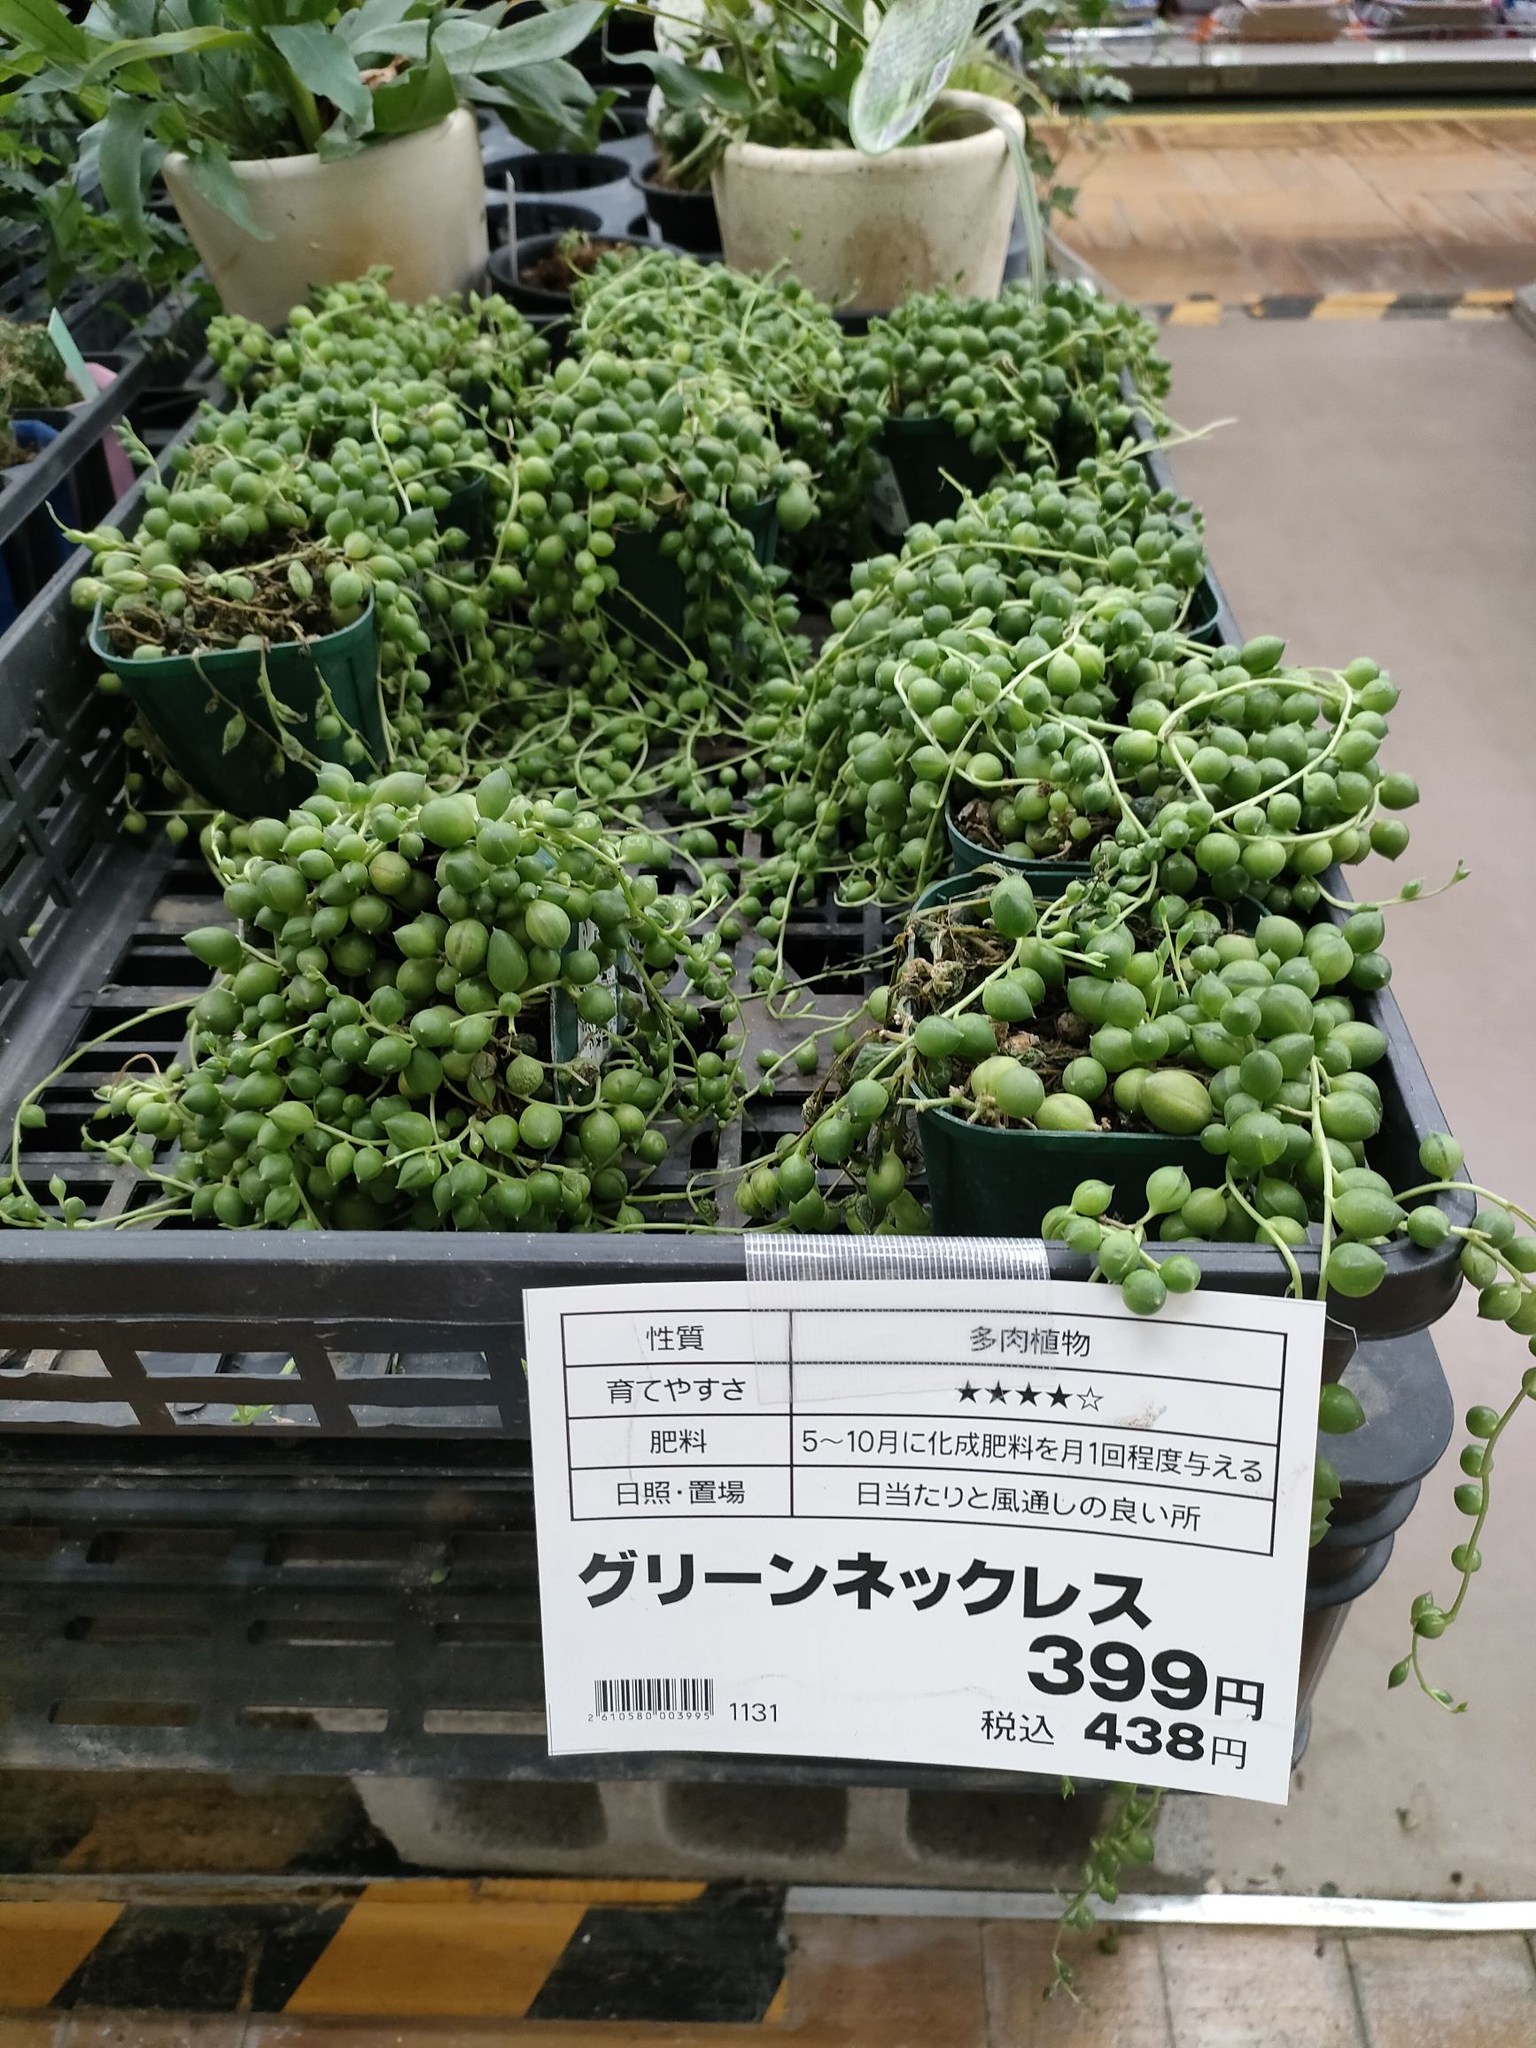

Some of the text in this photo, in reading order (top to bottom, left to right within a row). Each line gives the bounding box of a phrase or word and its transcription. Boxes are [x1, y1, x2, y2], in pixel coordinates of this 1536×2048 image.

[646, 1325, 705, 1352] 性質
[969, 1325, 1091, 1358] 多肉植物
[606, 1376, 747, 1405] 育てやすさ
[650, 1427, 708, 1455] 肥料
[856, 1481, 1202, 1532] 日当たりと風通しの良い所
[578, 1550, 1154, 1631] グリーンネックレス
[729, 1702, 778, 1723] 1131
[980, 1710, 1056, 1746] 税込
